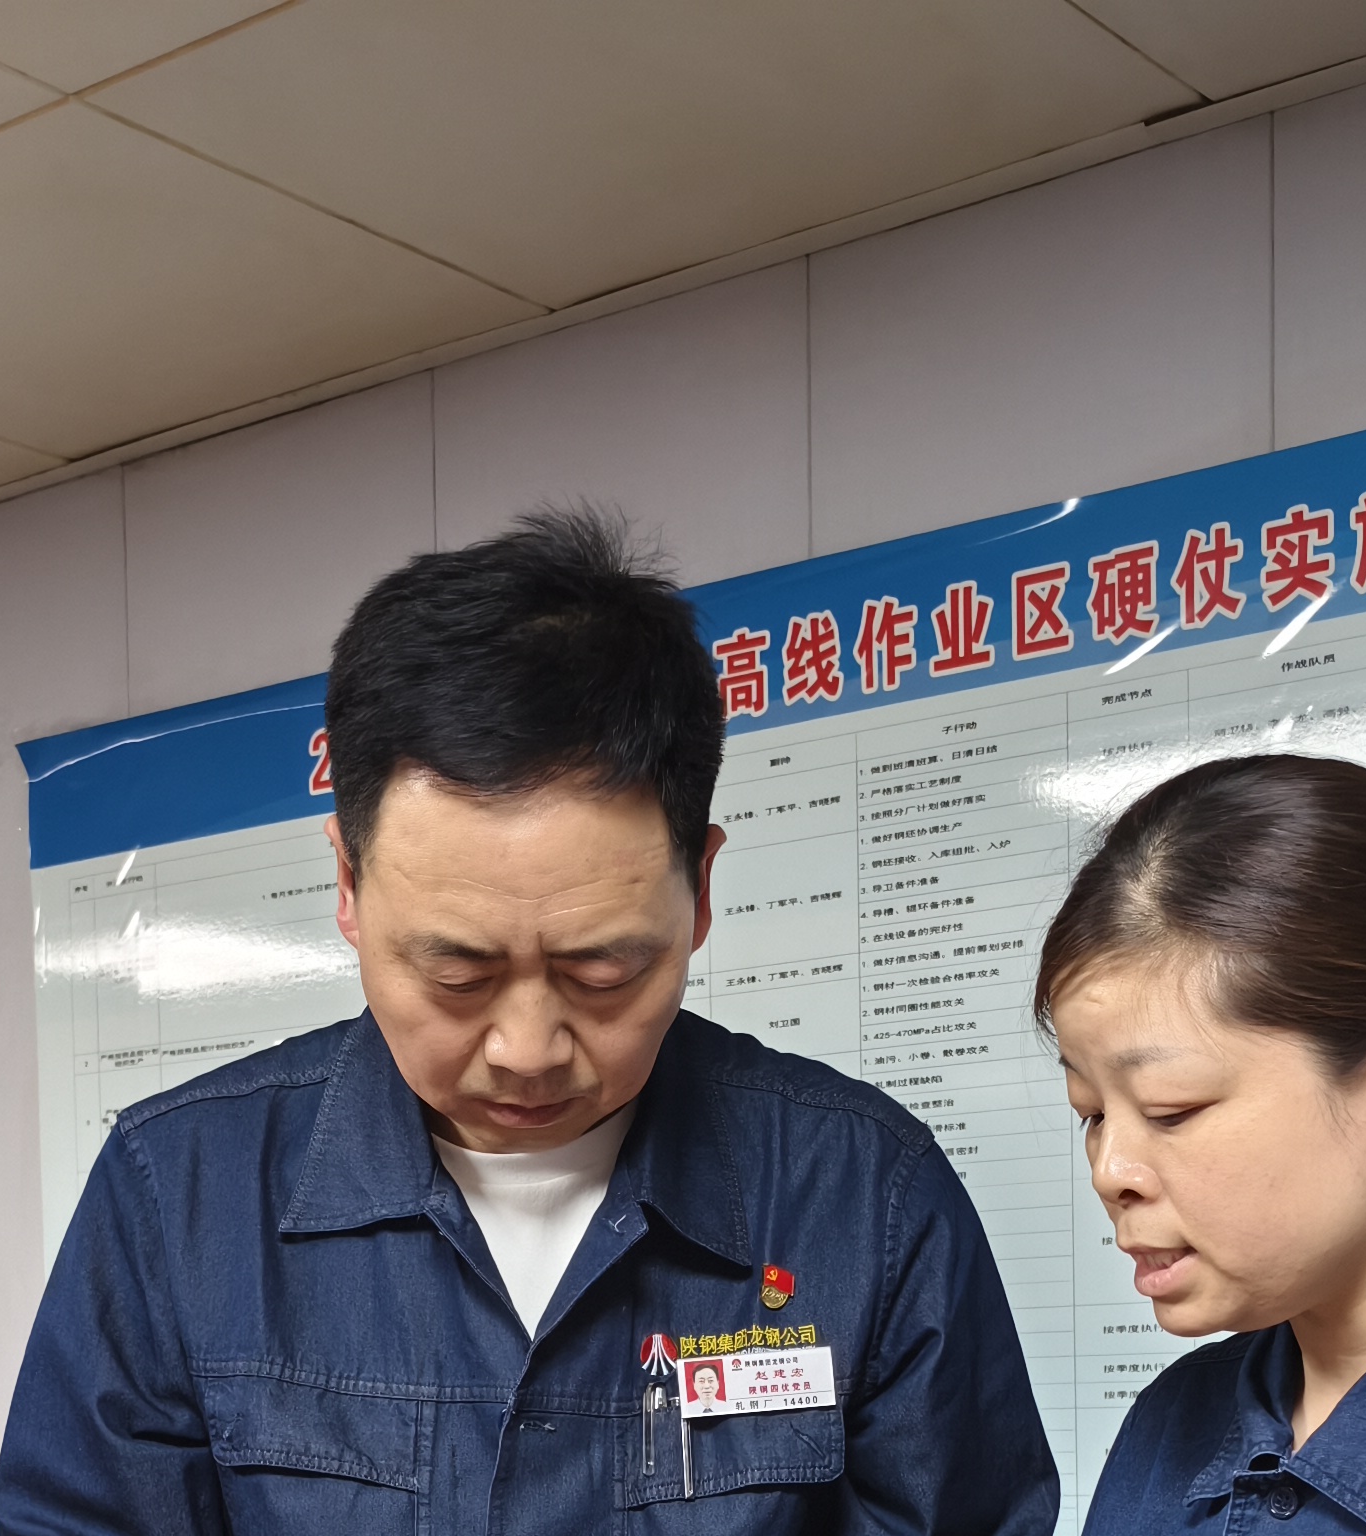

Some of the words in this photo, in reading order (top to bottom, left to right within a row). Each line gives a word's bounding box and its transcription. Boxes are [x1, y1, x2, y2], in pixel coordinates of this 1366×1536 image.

[1281, 653, 1336, 673] 作战队员
[1101, 688, 1153, 706] 完成节点
[941, 721, 977, 735] 子行动
[680, 1324, 816, 1358] 陕钢集团龙钢公司
[735, 1399, 773, 1411] 轧钢厂
[783, 1395, 819, 1407] 14400
